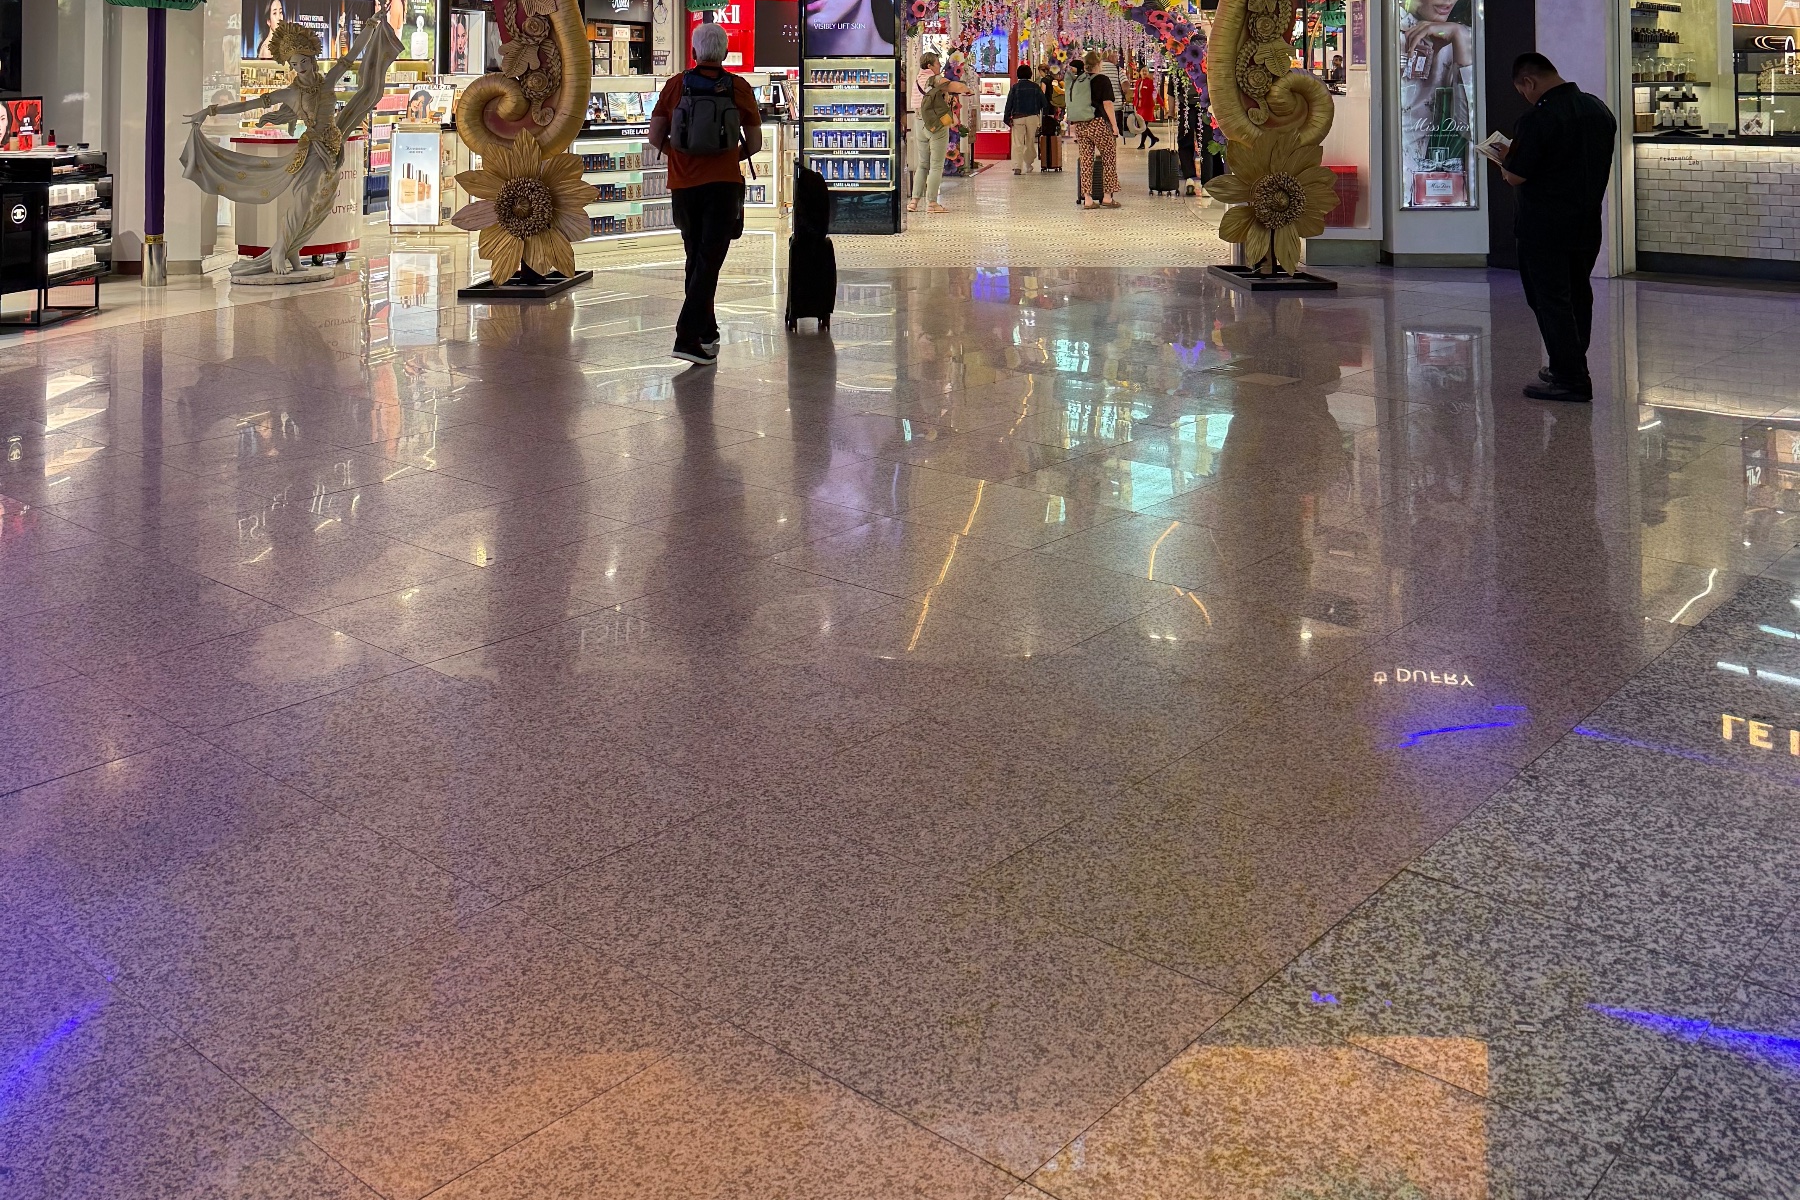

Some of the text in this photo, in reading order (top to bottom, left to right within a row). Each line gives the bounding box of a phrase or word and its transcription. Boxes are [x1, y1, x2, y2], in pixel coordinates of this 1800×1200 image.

[813, 22, 866, 30] VISIBLY LIFT SKIN
[1410, 116, 1470, 132] Miss Dior
